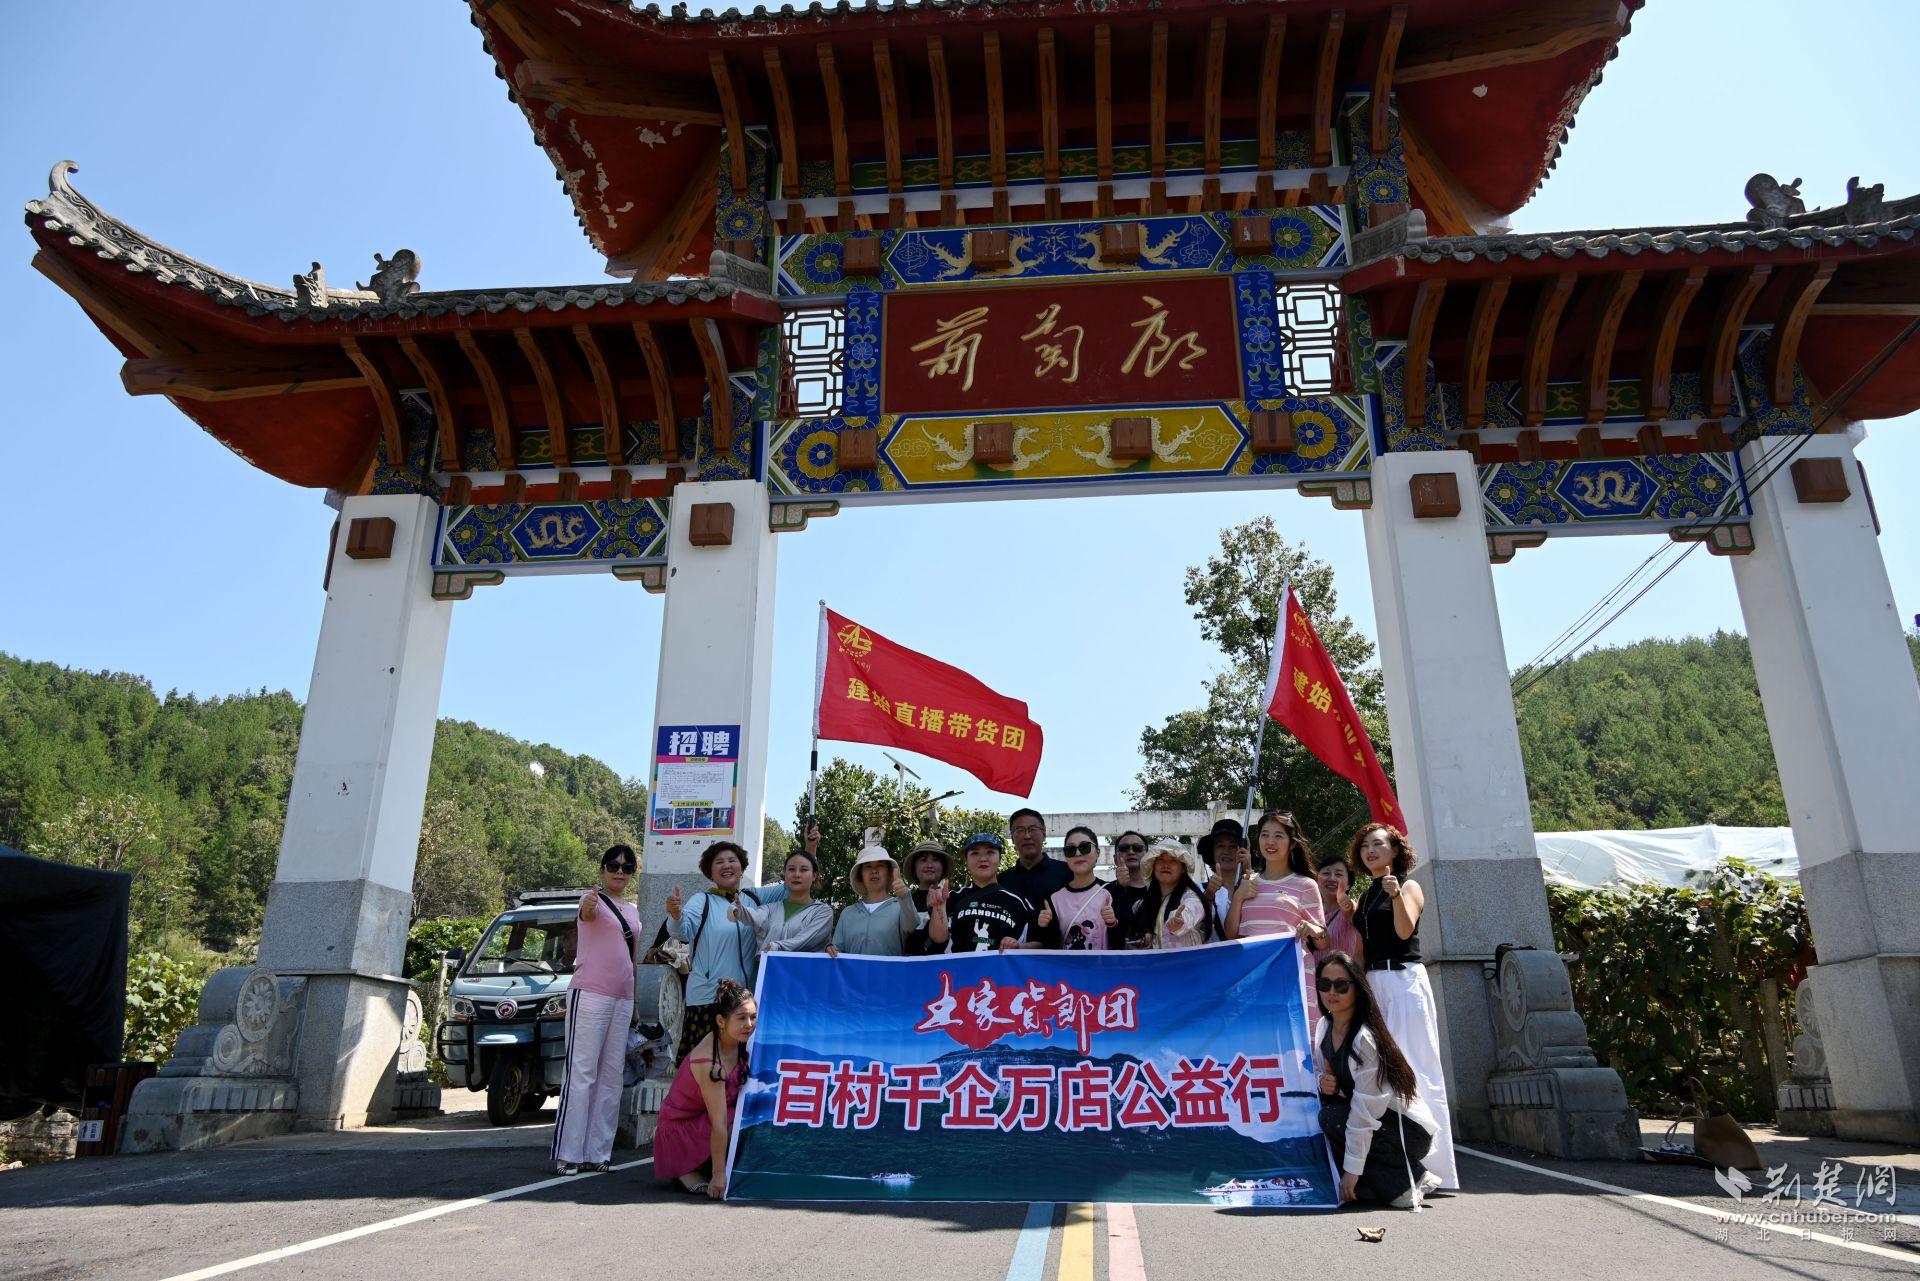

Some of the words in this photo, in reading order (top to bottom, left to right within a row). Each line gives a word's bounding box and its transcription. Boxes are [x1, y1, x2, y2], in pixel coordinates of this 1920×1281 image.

[668, 731, 730, 756] 招聘
[846, 677, 1026, 752] 建始直播带货团
[917, 973, 1136, 1051] 土家货郎团
[774, 1053, 1287, 1132] 百村千企万店公益行
